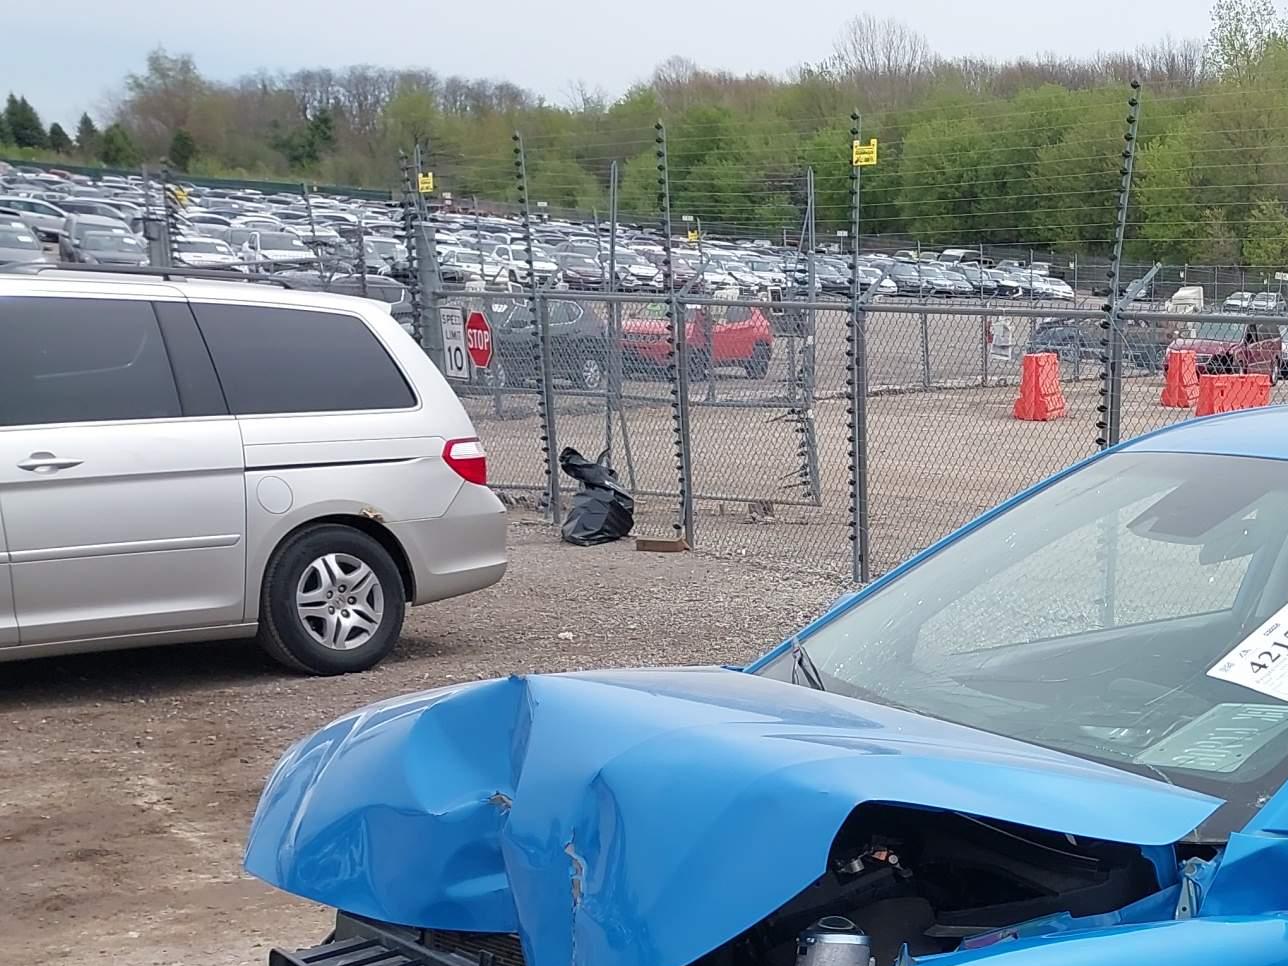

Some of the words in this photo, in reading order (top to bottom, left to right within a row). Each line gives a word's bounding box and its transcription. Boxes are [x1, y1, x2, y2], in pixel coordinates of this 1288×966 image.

[442, 314, 461, 325] SPEED
[445, 330, 461, 340] LIMIT
[467, 328, 489, 350] STOP
[447, 345, 464, 371] 10
